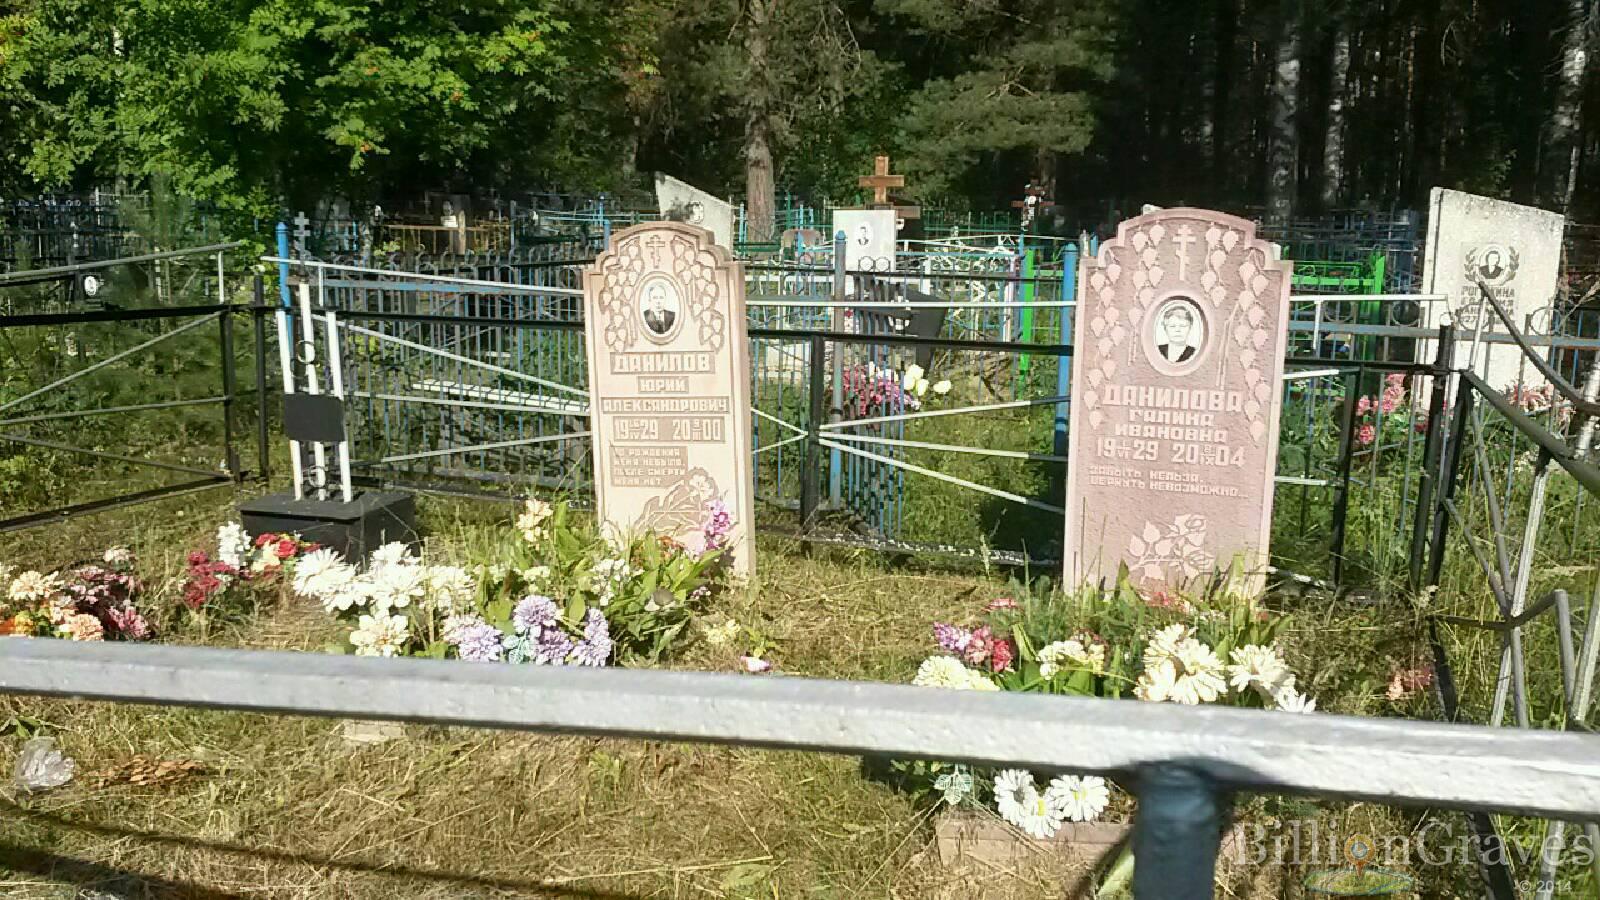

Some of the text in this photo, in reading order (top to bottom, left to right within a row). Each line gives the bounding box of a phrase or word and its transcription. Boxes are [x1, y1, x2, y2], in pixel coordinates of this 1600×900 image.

[613, 352, 711, 372] ДАНИЛОВ
[639, 378, 686, 392] ЮРИЙ
[602, 398, 728, 413] АЛЕКСАНДРОВИЧ
[1102, 384, 1243, 412] ДАНИЛОВА
[1128, 409, 1215, 427] ГАЛИНА
[1115, 423, 1228, 443] ИВАНОВНА
